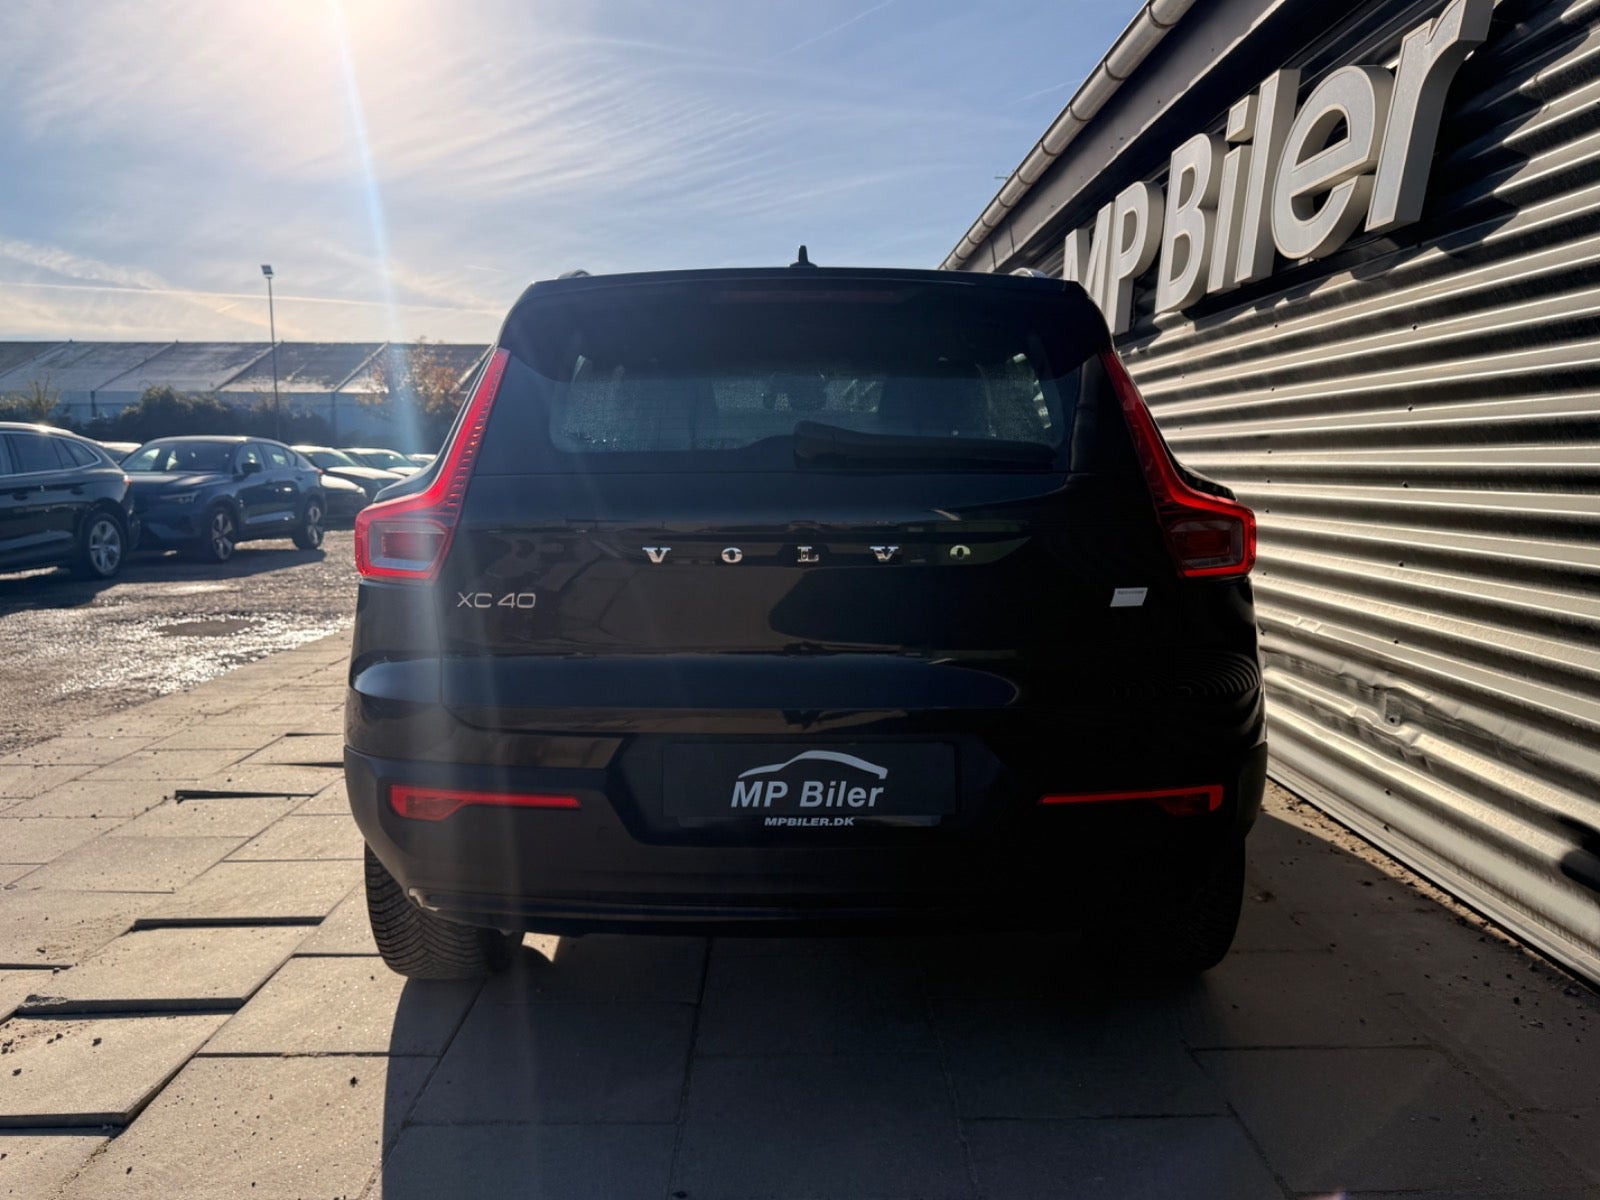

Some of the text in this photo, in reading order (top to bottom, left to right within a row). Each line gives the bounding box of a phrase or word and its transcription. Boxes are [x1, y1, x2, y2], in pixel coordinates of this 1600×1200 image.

[1063, 0, 1495, 334] MP Biler
[642, 545, 972, 563] VOLVO
[730, 781, 885, 808] MP Biler
[764, 816, 855, 827] MPBILER.DK
